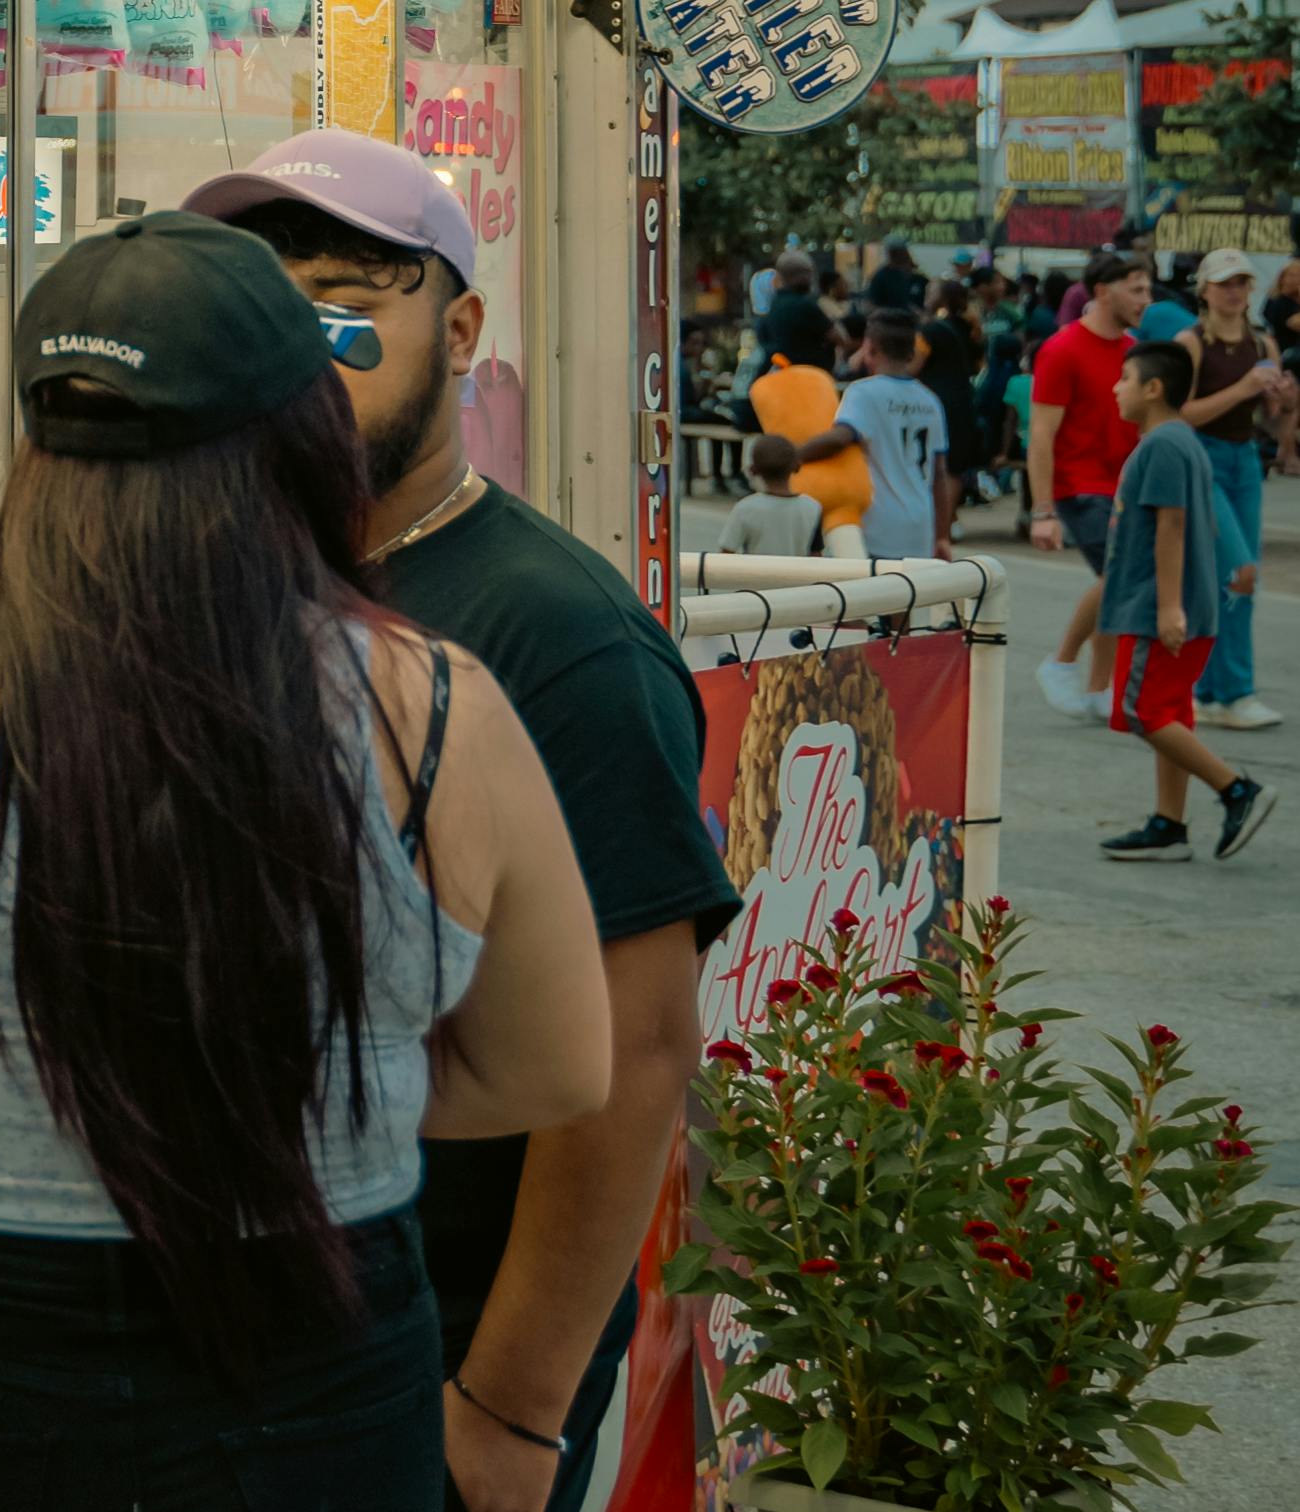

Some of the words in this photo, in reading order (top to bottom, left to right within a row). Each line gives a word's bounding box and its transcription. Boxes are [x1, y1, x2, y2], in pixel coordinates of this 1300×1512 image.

[877, 190, 977, 222] GATOR
[41, 337, 56, 356] EL
[58, 333, 145, 369] SALVADOR
[778, 743, 857, 884] The
